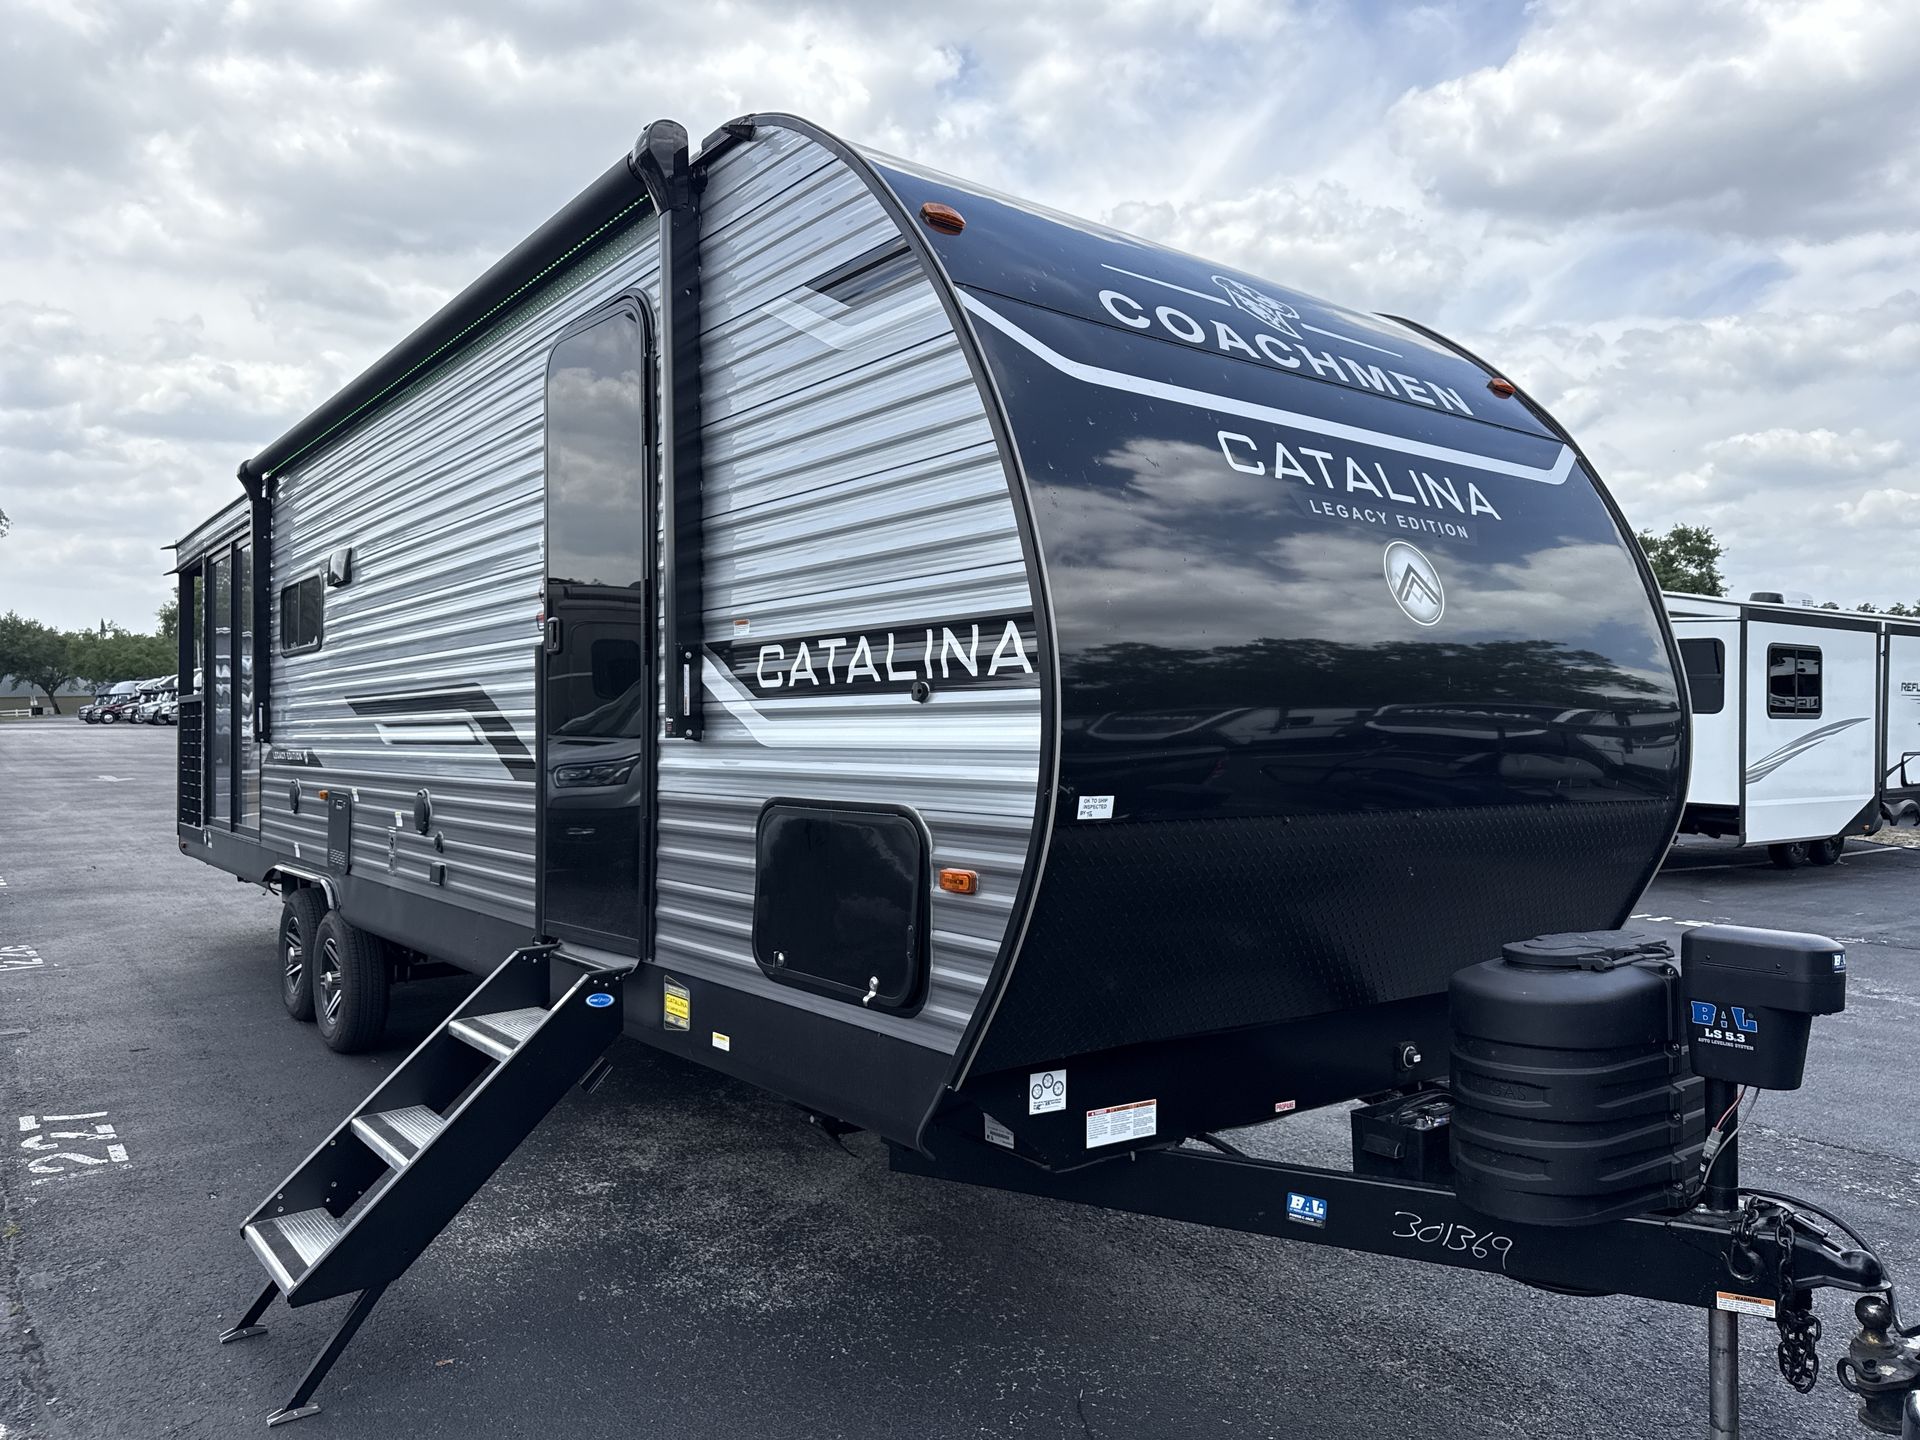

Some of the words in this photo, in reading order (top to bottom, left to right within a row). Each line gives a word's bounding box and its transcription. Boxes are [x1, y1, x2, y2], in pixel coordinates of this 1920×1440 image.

[1098, 289, 1474, 416] COACHMEN
[1216, 430, 1502, 520] CATALINA
[1309, 499, 1387, 525] LEGACY
[1395, 514, 1469, 539] EDITION
[756, 620, 1034, 688] CATALINA
[1691, 1001, 1758, 1033] BAL
[1704, 1028, 1722, 1039] LS
[1725, 1031, 1746, 1043] 5.3
[1711, 1039, 1734, 1048] LEVELING
[1734, 1043, 1754, 1051] SYSTEM
[1276, 1101, 1294, 1111] PROPANE
[1290, 1195, 1324, 1215] BAL
[1392, 1211, 1513, 1270] 301369
[1734, 1295, 1762, 1304] WARNING
